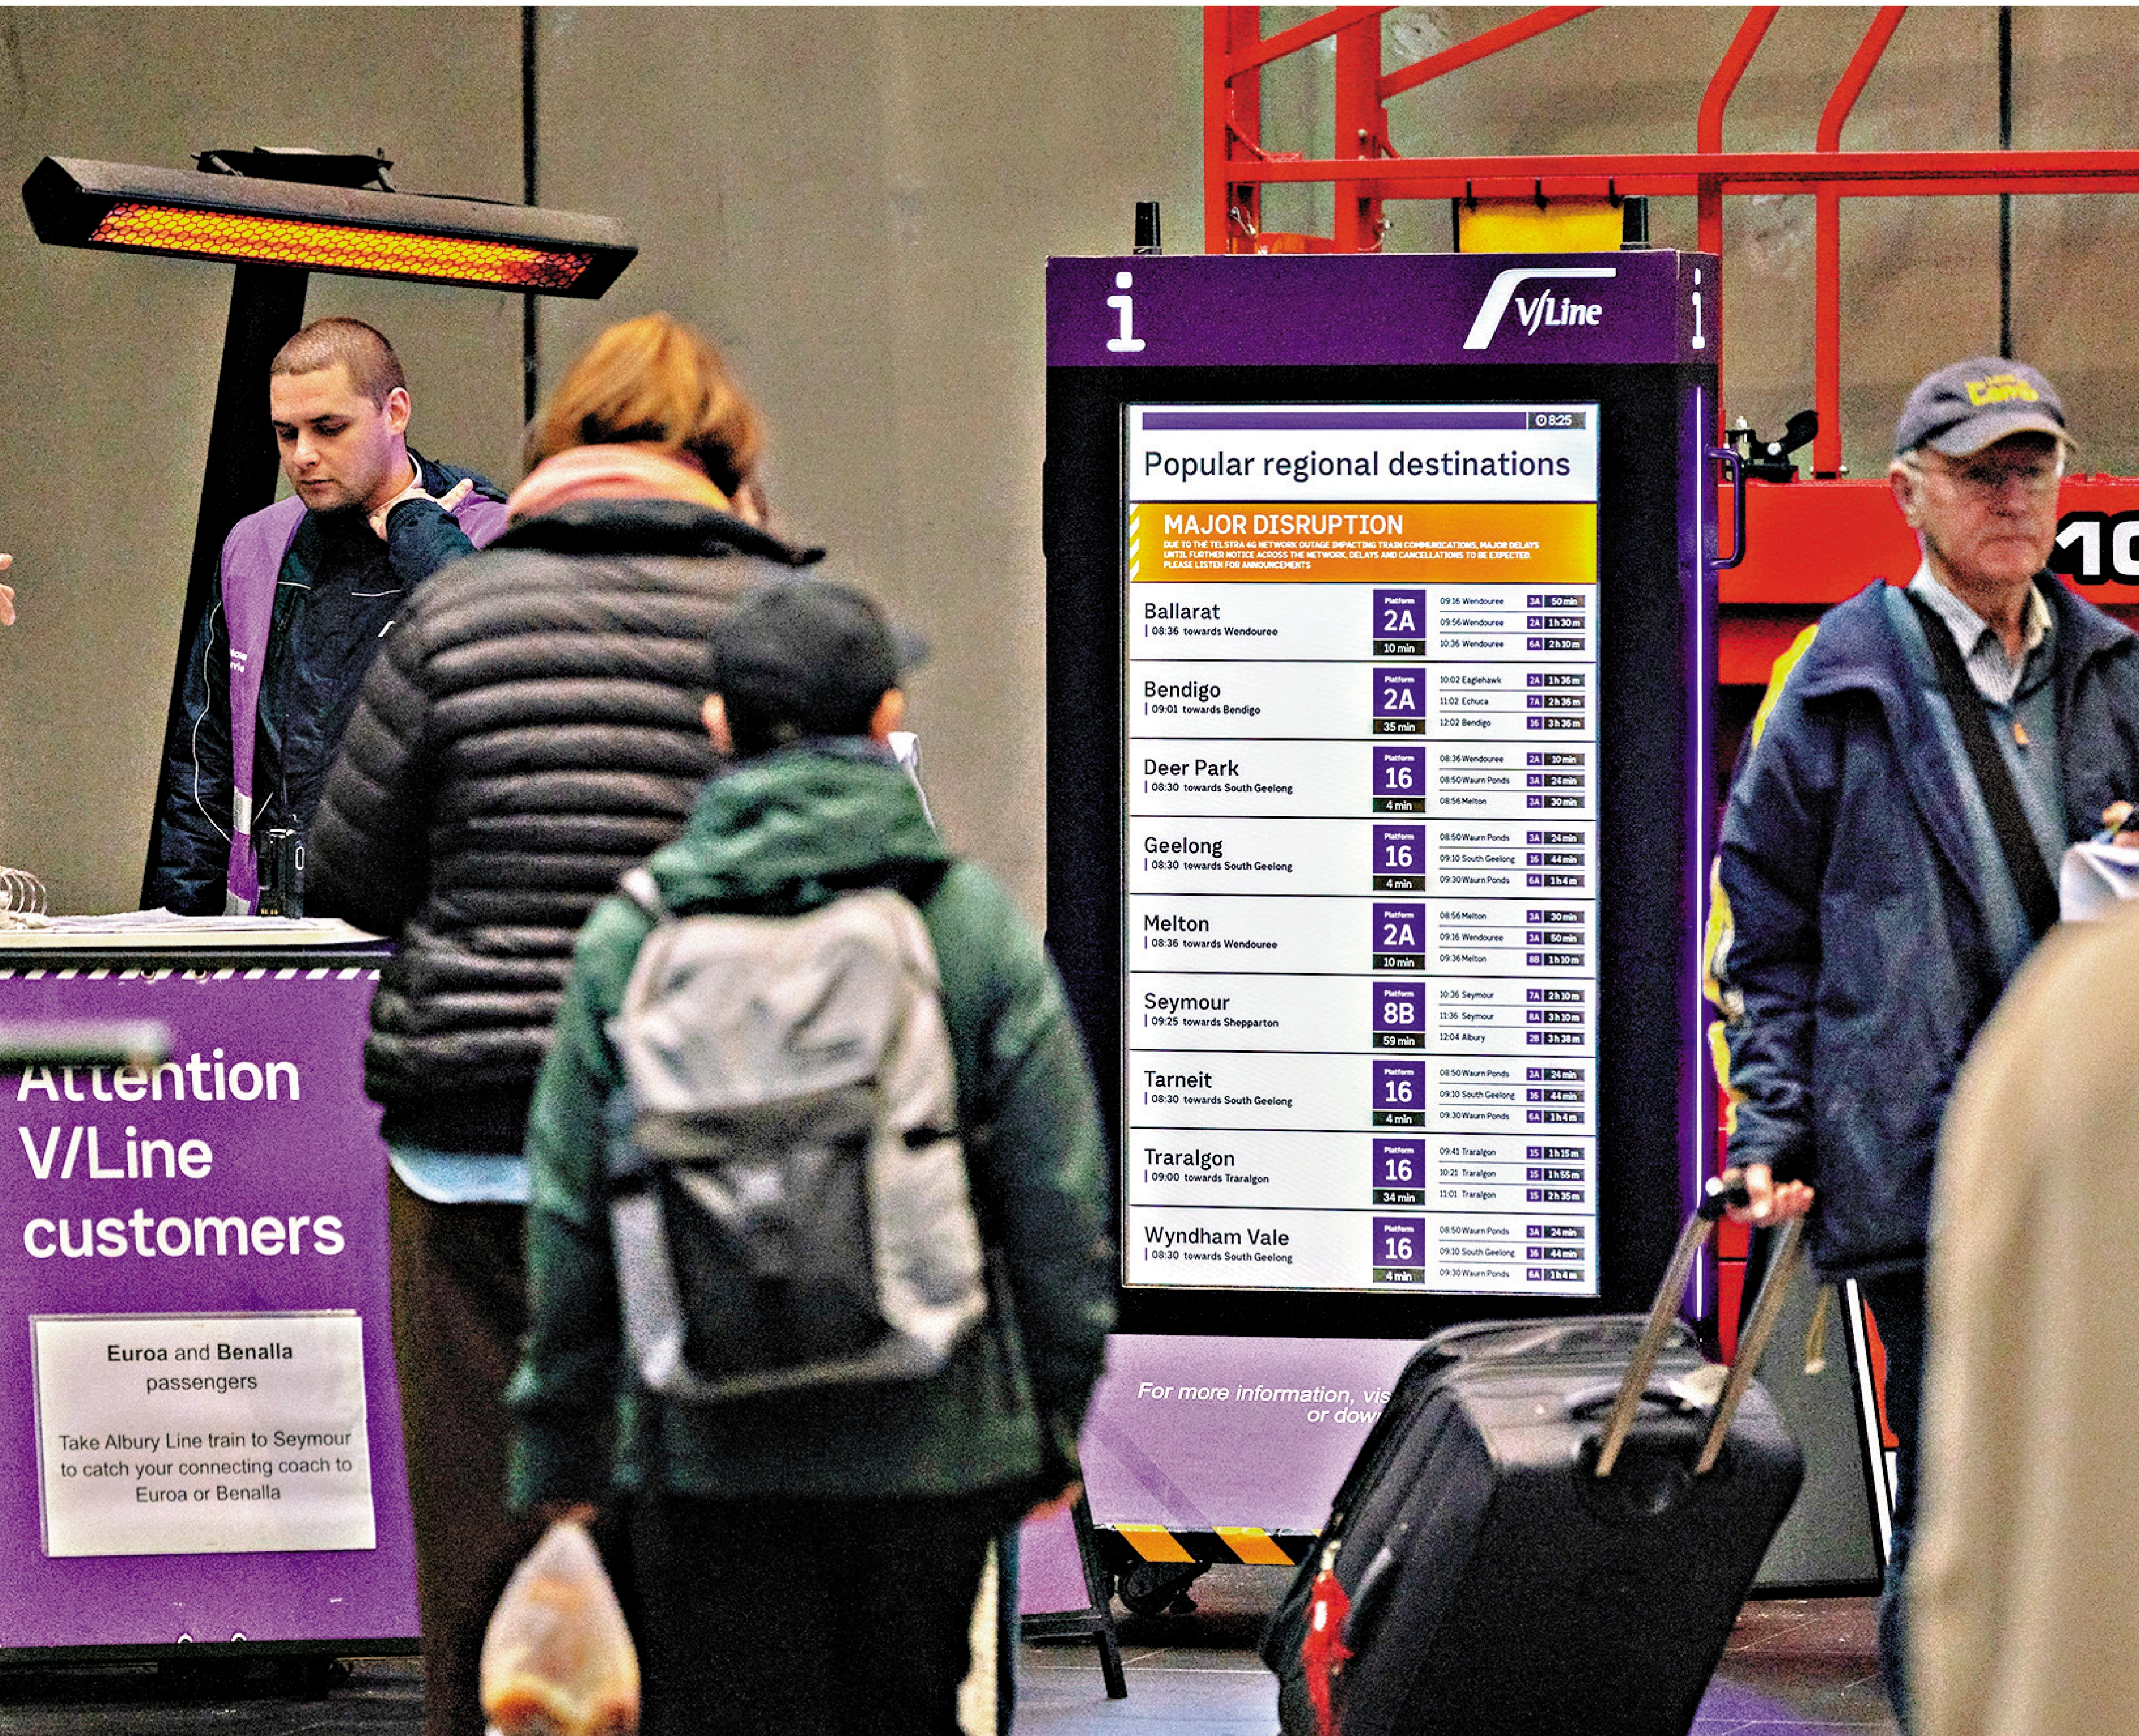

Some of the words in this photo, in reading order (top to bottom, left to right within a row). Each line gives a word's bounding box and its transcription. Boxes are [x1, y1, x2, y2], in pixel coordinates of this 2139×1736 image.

[1515, 288, 1602, 337] V/Line
[1145, 451, 1256, 482] Popular
[1264, 449, 1378, 483] regional
[1388, 449, 1571, 476] destinations
[1164, 513, 1247, 534] MAJOR
[1254, 514, 1402, 534] DISRUPTION
[1145, 603, 1221, 621] Ballarat
[1384, 609, 1415, 631] 2A
[1151, 626, 1180, 636] 08:36
[1183, 628, 1222, 636] towards
[1223, 628, 1278, 636] Wendouree
[1384, 643, 1396, 653] 10
[1397, 643, 1415, 653] min
[1145, 681, 1221, 702] Bendigo
[1383, 687, 1415, 709] 2A
[1440, 697, 1460, 705] 11:02
[1461, 697, 1489, 705] Echuca
[1151, 704, 1177, 713] 09:01
[1183, 704, 1222, 715] towards
[1223, 704, 1261, 717] Bendigo
[1383, 721, 1396, 731] 35
[1397, 721, 1415, 731] min
[1440, 717, 1460, 726] 12:02
[1461, 717, 1491, 729] Bendigo
[1145, 758, 1189, 776] Deer
[1194, 759, 1239, 776] Park
[1385, 767, 1413, 789] 16
[1151, 781, 1180, 792] 08:30
[1183, 783, 1222, 792] towards
[1225, 783, 1253, 793] South
[1254, 783, 1294, 796] Geelong
[1386, 800, 1393, 810] 4
[1394, 800, 1413, 810] min
[1145, 836, 1223, 859] Geelong
[1385, 846, 1413, 868] 16
[1151, 860, 1180, 871] 08:30
[1183, 861, 1222, 871] towards
[1223, 861, 1252, 871] South
[1254, 861, 1294, 874] Geelong
[1385, 879, 1393, 889] 4
[1394, 879, 1413, 889] min
[1143, 915, 1209, 932] Melton
[1383, 923, 1415, 946] 2A
[1151, 939, 1179, 947] 08:36
[1183, 939, 1222, 949] towards
[1223, 939, 1278, 949] Wendouree
[1384, 957, 1396, 967] 10
[1397, 958, 1414, 967] min
[1145, 992, 1231, 1014] Seymour
[1439, 989, 1460, 998] 10:36
[1461, 991, 1494, 1000] Seymour
[1151, 1015, 1179, 1026] 09:25
[1183, 1017, 1222, 1026] towards
[1223, 1017, 1279, 1028] Shepparton
[1383, 1001, 1414, 1024] 8B
[1383, 1035, 1396, 1045] 59
[1397, 1035, 1415, 1045] min
[1461, 1032, 1486, 1043] Albury
[16, 1048, 300, 1102] Attention
[1143, 1070, 1213, 1089] Tarneit
[1385, 1080, 1413, 1103] 16
[1151, 1094, 1180, 1105] 08:30
[1183, 1095, 1222, 1105] towards
[1223, 1095, 1252, 1106] South
[1254, 1095, 1294, 1108] Geelong
[1385, 1114, 1393, 1124] 4
[1394, 1114, 1411, 1124] min
[18, 1126, 213, 1179] V/Line
[1143, 1148, 1235, 1170] Traralgon
[1151, 1172, 1180, 1182] 09:00
[1184, 1172, 1223, 1183] towards
[1225, 1173, 1269, 1186] Traralgon
[1385, 1160, 1413, 1182] 16
[1383, 1192, 1396, 1202] 34
[1397, 1192, 1415, 1202] min
[23, 1208, 345, 1258] customers
[1143, 1226, 1242, 1248] Wyndham
[1247, 1229, 1290, 1245] Vale
[1151, 1250, 1180, 1260] 08:30
[1184, 1251, 1222, 1261] towards
[1225, 1251, 1252, 1261] South
[1254, 1252, 1292, 1264] Geelong
[1385, 1237, 1413, 1260] 16
[1385, 1271, 1393, 1281] 4
[1393, 1271, 1413, 1281] min
[107, 1344, 168, 1362] Euroa
[174, 1344, 210, 1361] and
[217, 1342, 293, 1360] Benalla
[147, 1377, 258, 1394] passengers
[1137, 1382, 1173, 1399] For
[1177, 1387, 1230, 1402] more
[1235, 1384, 1354, 1405] information,
[1363, 1387, 1392, 1404] vis
[1307, 1411, 1330, 1422] or
[1333, 1407, 1381, 1424] dow
[60, 1436, 100, 1450] Take
[105, 1434, 160, 1454] Albury
[165, 1433, 202, 1449] Line
[208, 1433, 245, 1448] train
[252, 1432, 268, 1448] to
[273, 1430, 351, 1450] Seymour
[61, 1463, 78, 1477] to
[83, 1461, 129, 1477] catch
[135, 1463, 173, 1480] your
[178, 1459, 273, 1478] connecting
[278, 1458, 330, 1473] coach
[335, 1458, 352, 1472] to
[135, 1486, 187, 1503] Euroa
[193, 1489, 210, 1501] or
[216, 1484, 281, 1501] Benalla
